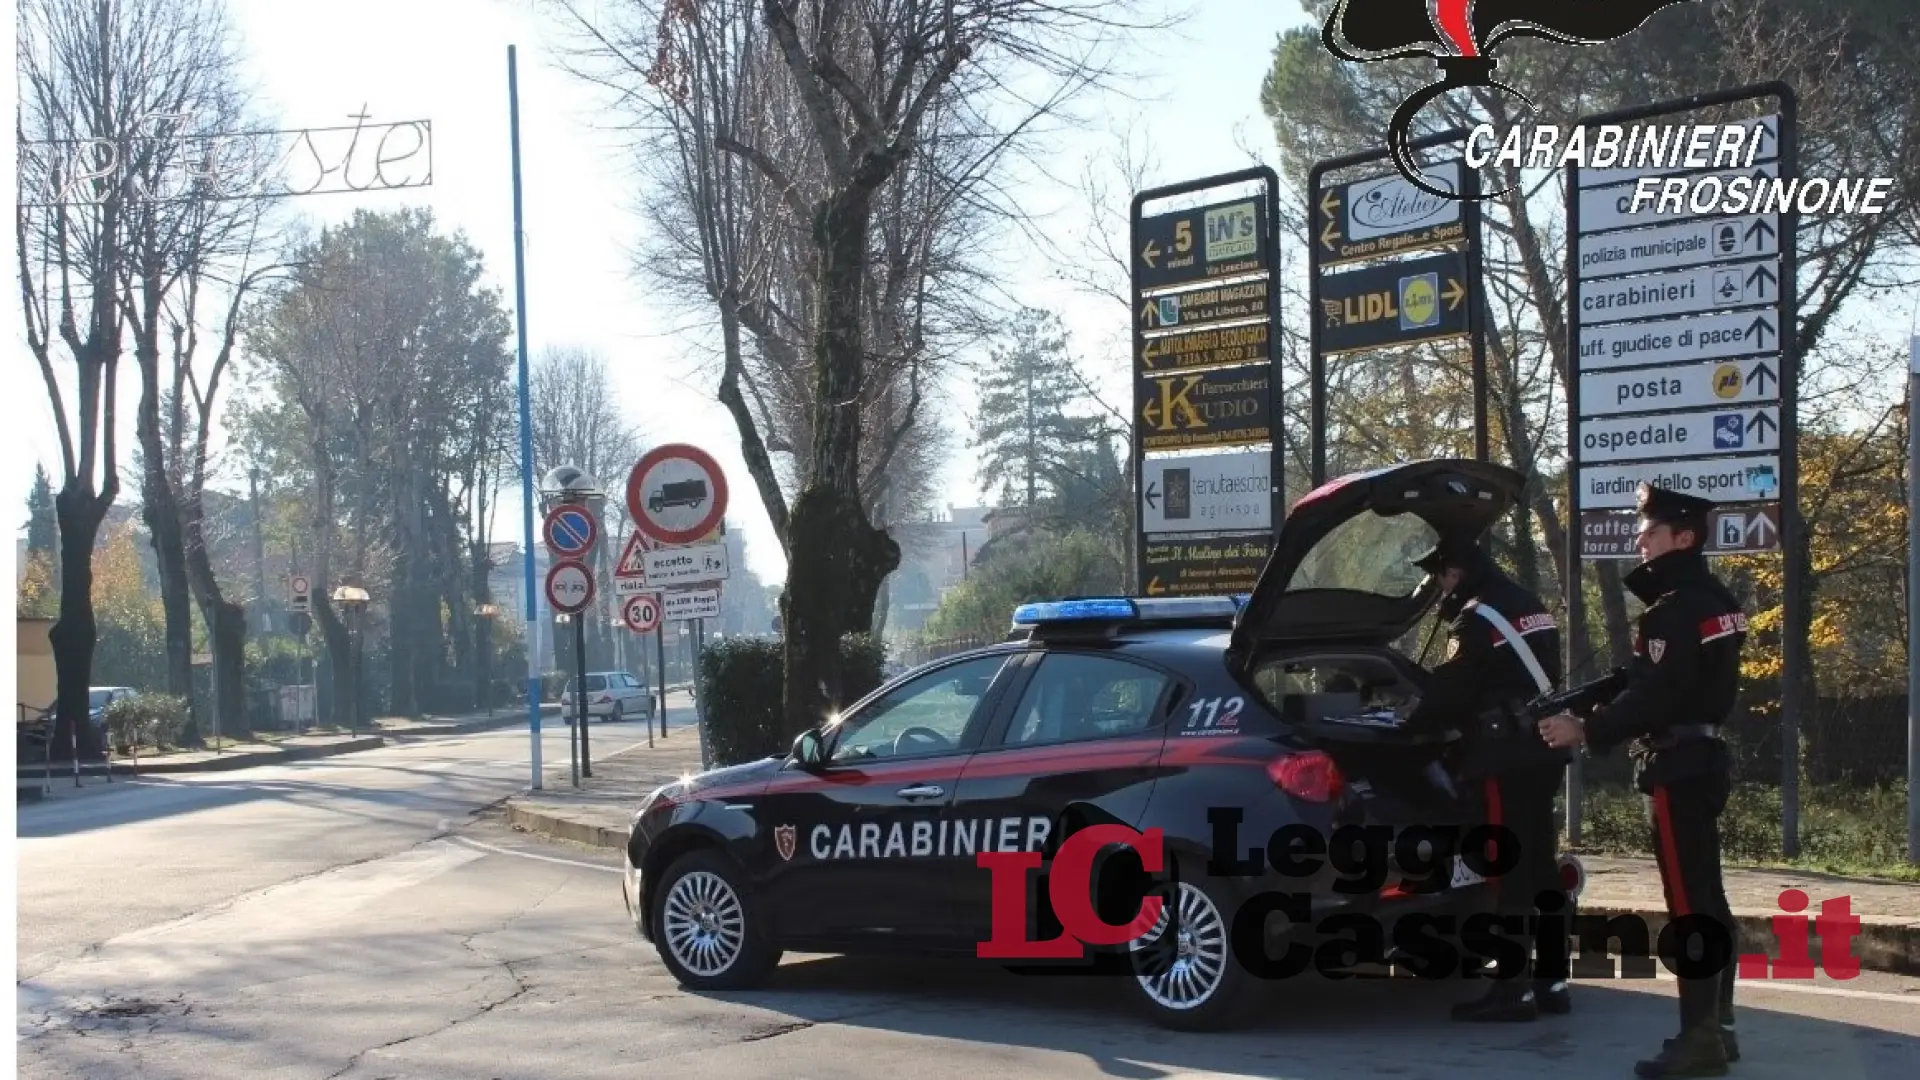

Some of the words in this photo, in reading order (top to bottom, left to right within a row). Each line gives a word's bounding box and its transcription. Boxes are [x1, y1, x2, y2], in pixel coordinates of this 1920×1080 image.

[1341, 242, 1376, 257] Centro
[1433, 223, 1463, 241] Sposi
[1582, 242, 1627, 268] polizia
[1630, 235, 1706, 258] municipale
[1344, 291, 1398, 325] LIDL
[1582, 279, 1695, 311] carabinieri
[1580, 339, 1605, 358] uff.
[1612, 335, 1672, 357] giudice
[1678, 330, 1693, 346] di
[1700, 326, 1742, 349] pace
[1617, 377, 1682, 404] posta
[1583, 423, 1688, 451] ospedale
[1697, 470, 1744, 492] sport
[653, 555, 693, 569] eccetto
[620, 579, 644, 591] rialz
[632, 605, 653, 623] 30
[1187, 696, 1245, 728] 112
[810, 816, 1051, 859] CARABINIER
